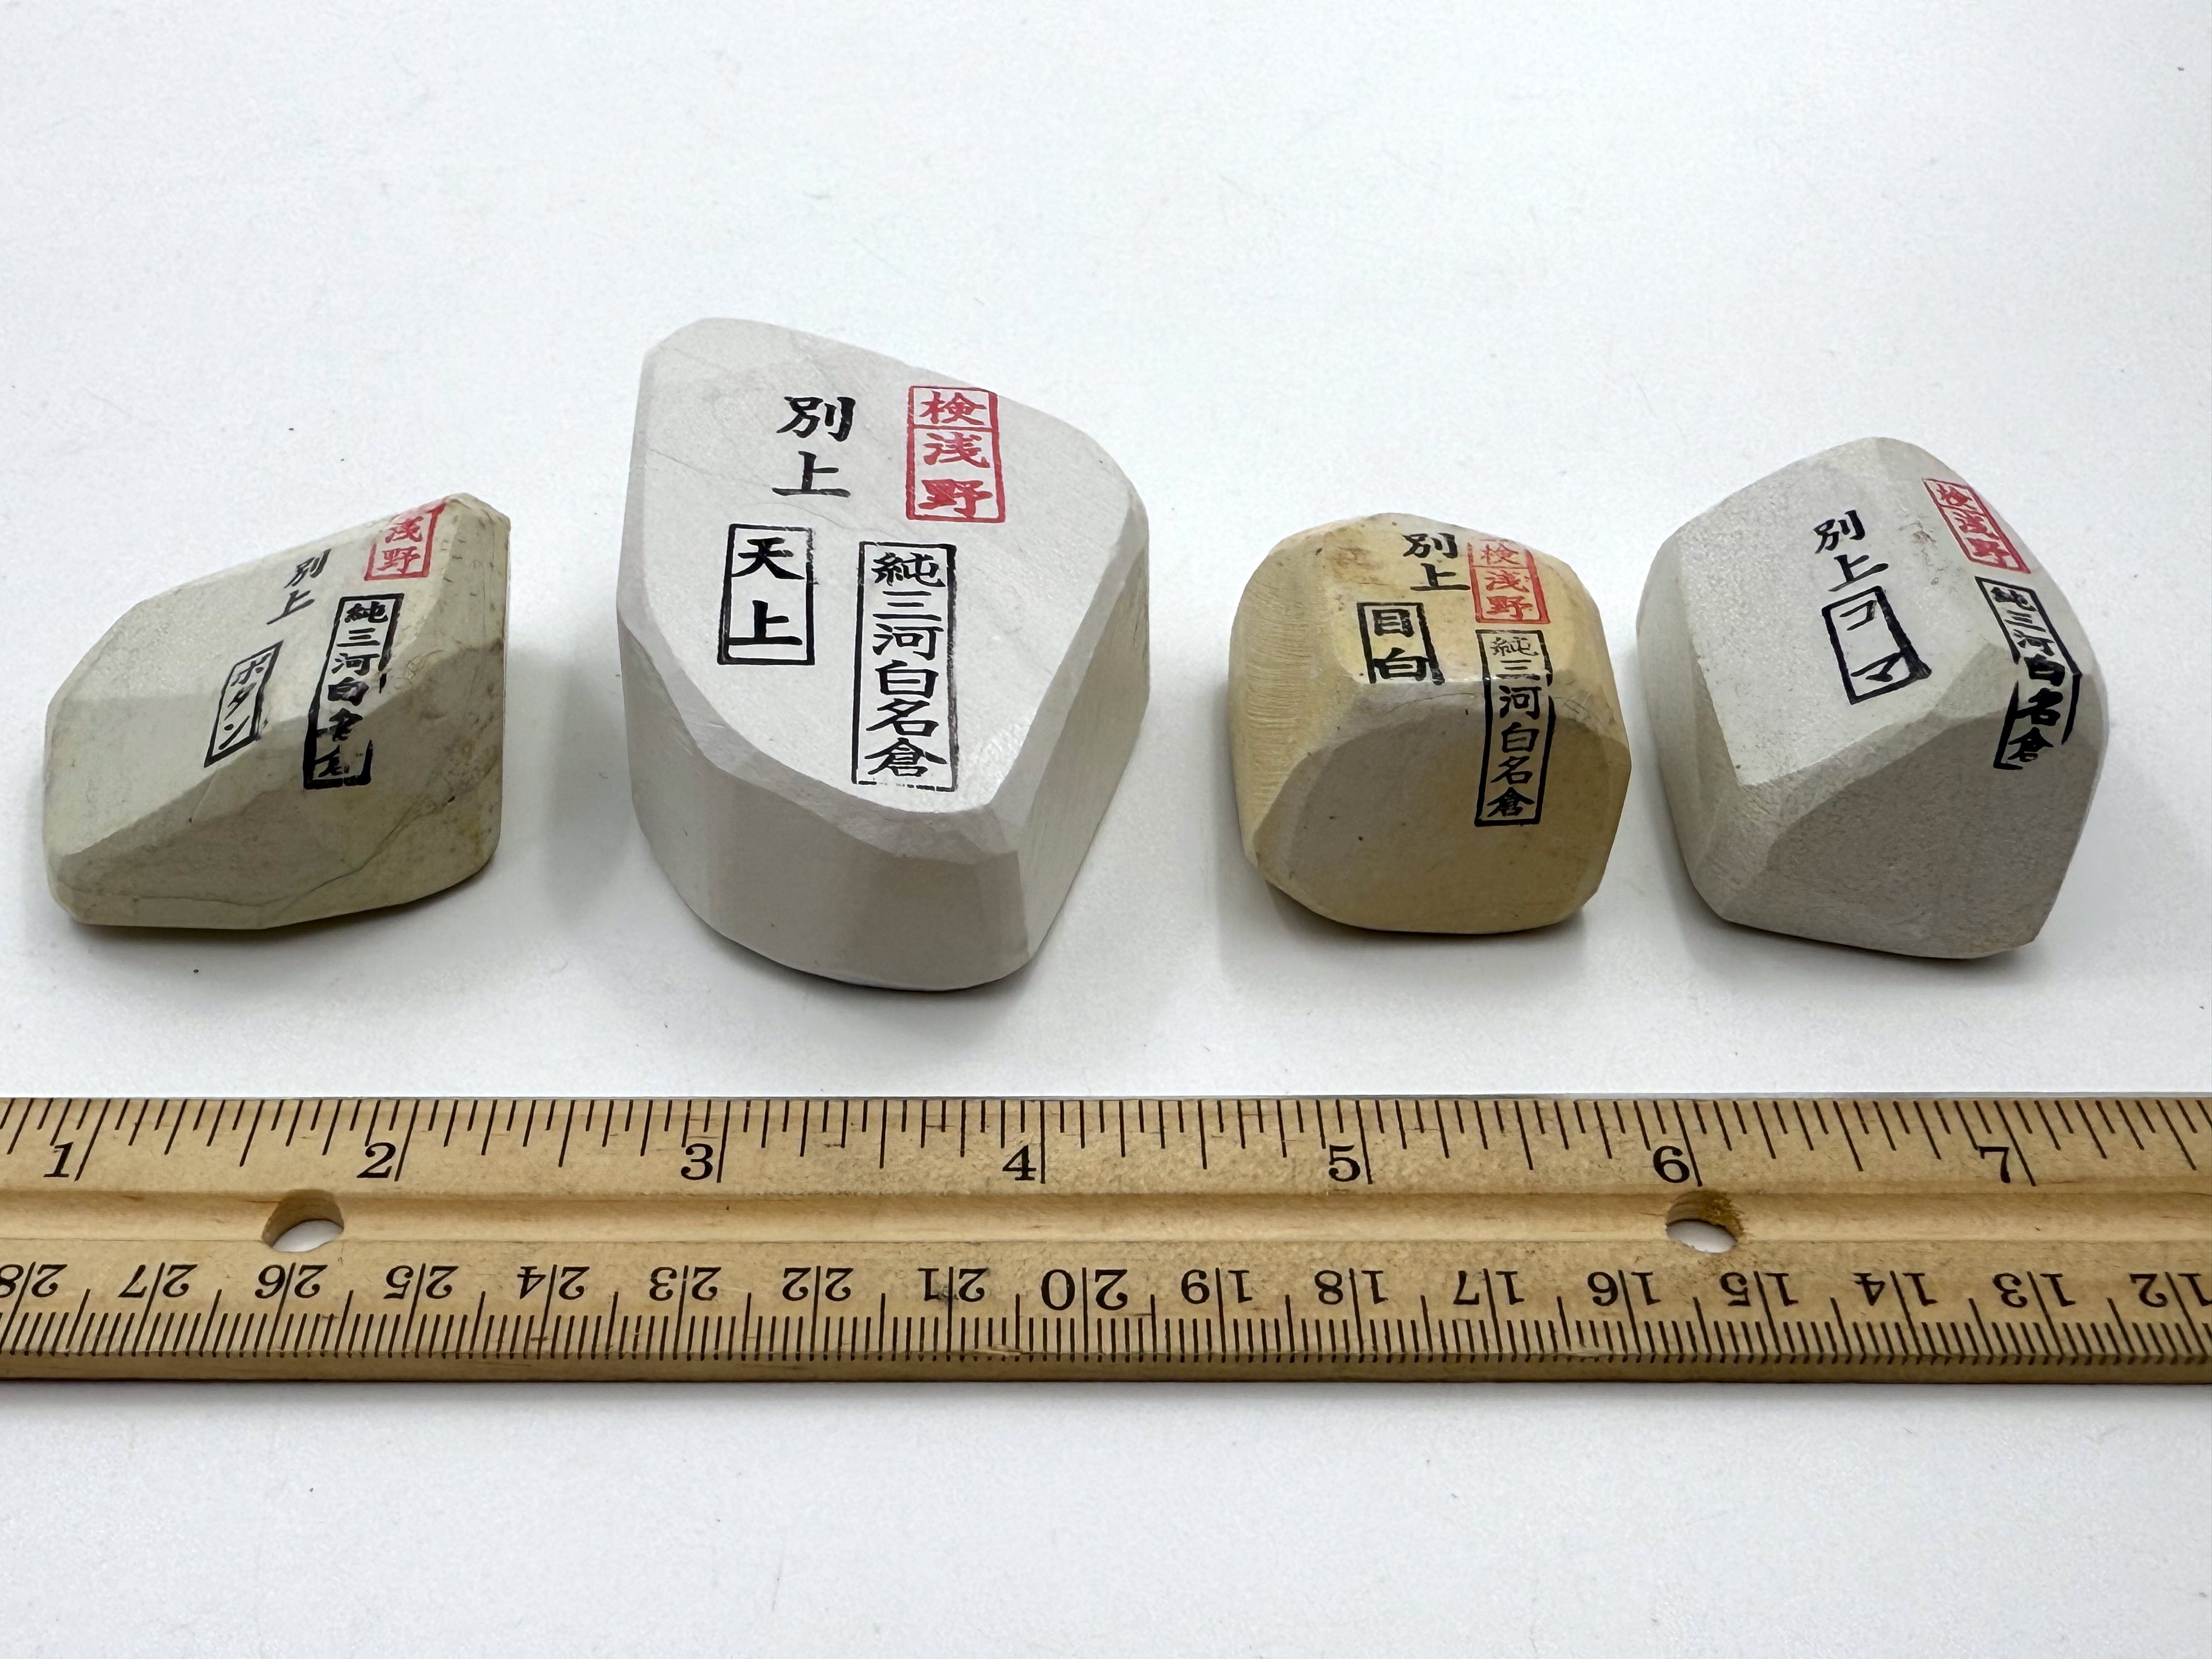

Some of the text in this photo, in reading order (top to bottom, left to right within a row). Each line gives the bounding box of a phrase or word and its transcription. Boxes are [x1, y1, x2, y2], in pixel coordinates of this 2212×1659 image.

[772, 396, 856, 498] 別上
[918, 391, 993, 518] 検浅野
[266, 548, 332, 625] 別上
[730, 537, 805, 646] 天上
[1402, 533, 1471, 591] 別上
[1813, 510, 1889, 592] 別上
[865, 552, 947, 778] 純三河白名倉
[1372, 608, 1430, 680] 目白
[1839, 600, 1905, 682] コマ
[1487, 636, 1543, 817] 純三河白名倉
[44, 1142, 2011, 1183] 1 2 3 4 5 6 7
